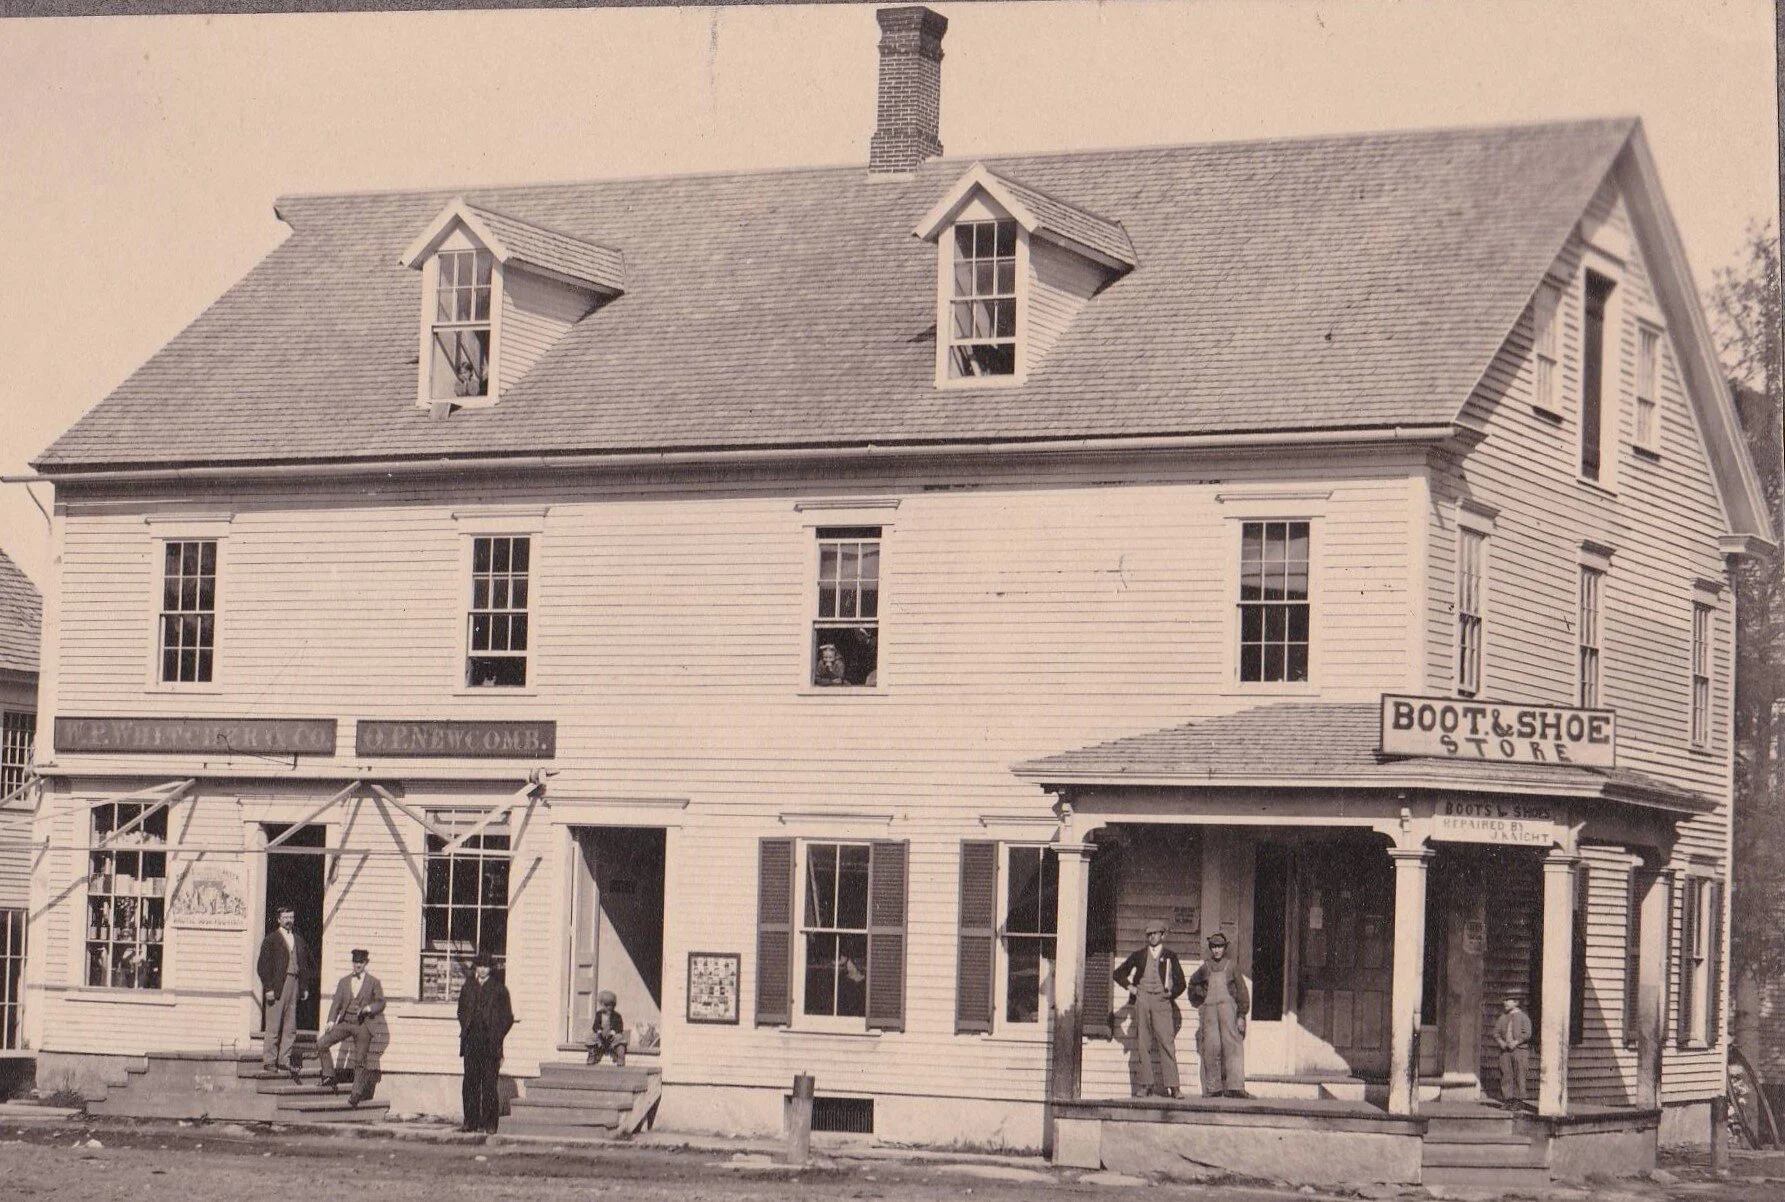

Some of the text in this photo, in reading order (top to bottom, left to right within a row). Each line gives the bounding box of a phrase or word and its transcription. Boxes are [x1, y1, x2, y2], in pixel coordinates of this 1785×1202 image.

[1491, 708, 1515, 738] &
[1516, 710, 1611, 745] SHOE
[1439, 734, 1573, 763] STORE
[1445, 802, 1492, 816] BOOTS
[1514, 803, 1550, 819] SHOES
[1443, 818, 1524, 832] REPAIRED BY
